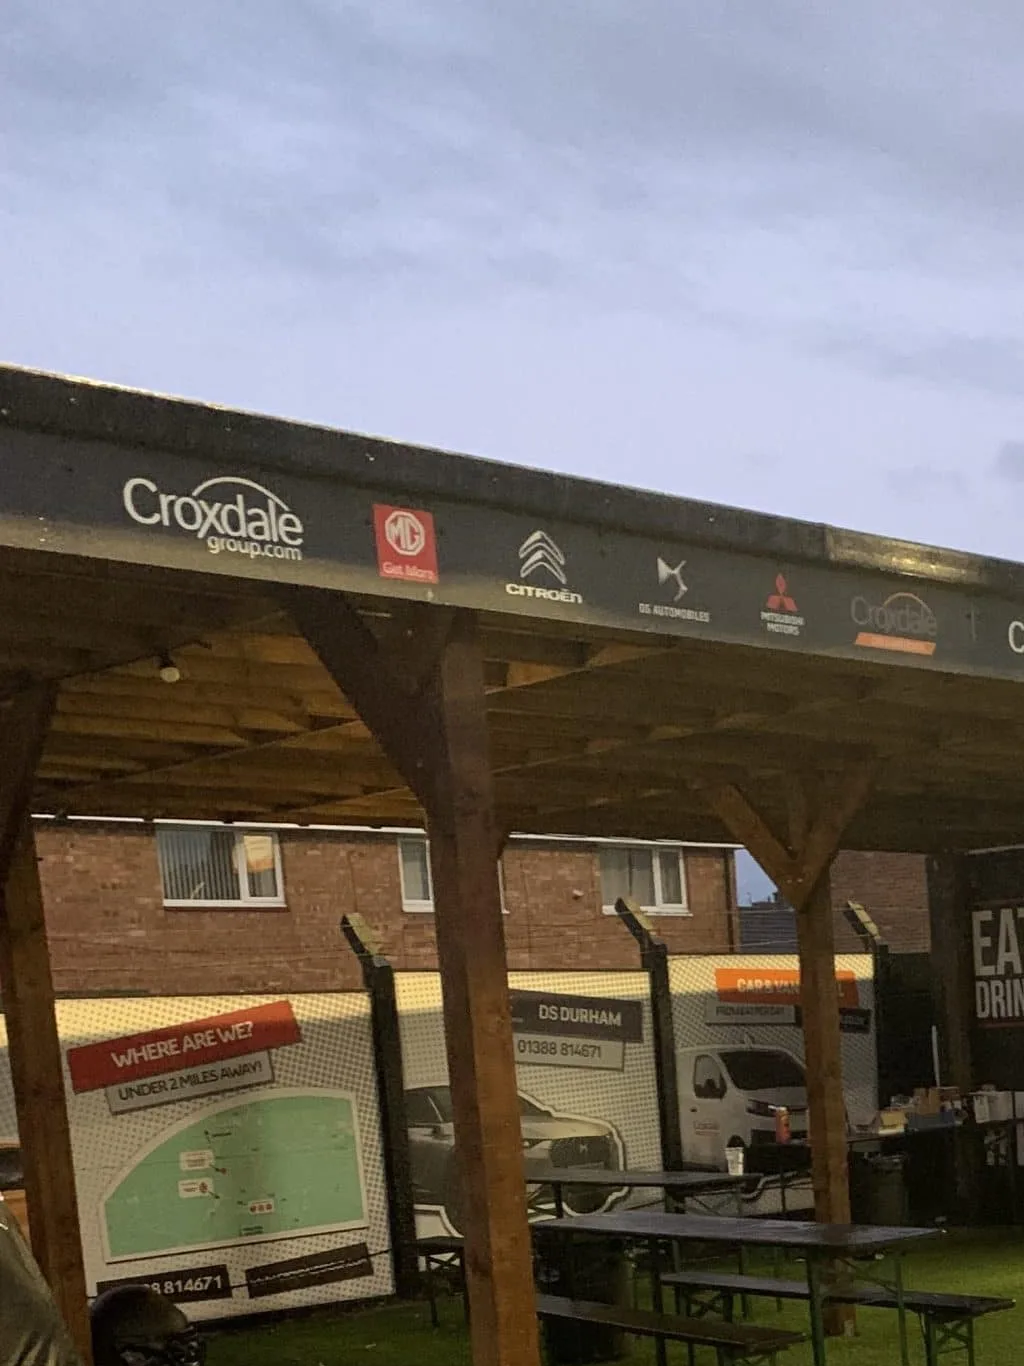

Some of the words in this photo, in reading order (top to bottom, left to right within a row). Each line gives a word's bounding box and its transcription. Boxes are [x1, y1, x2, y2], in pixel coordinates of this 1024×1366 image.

[122, 477, 304, 546] Croxdale
[207, 534, 302, 561] group.com
[538, 1004, 559, 1021] DS
[560, 1006, 622, 1027] DURHAM
[111, 1038, 181, 1068] WHERE
[182, 1028, 220, 1054] ARE
[219, 1020, 254, 1045] WE?
[517, 1039, 558, 1055] 01388
[560, 1042, 602, 1059] 814671
[118, 1081, 168, 1102] UNDER
[169, 1075, 180, 1091] 2
[180, 1069, 219, 1090] MILES
[219, 1060, 263, 1082] AWAY!
[163, 1275, 222, 1295] 814671
